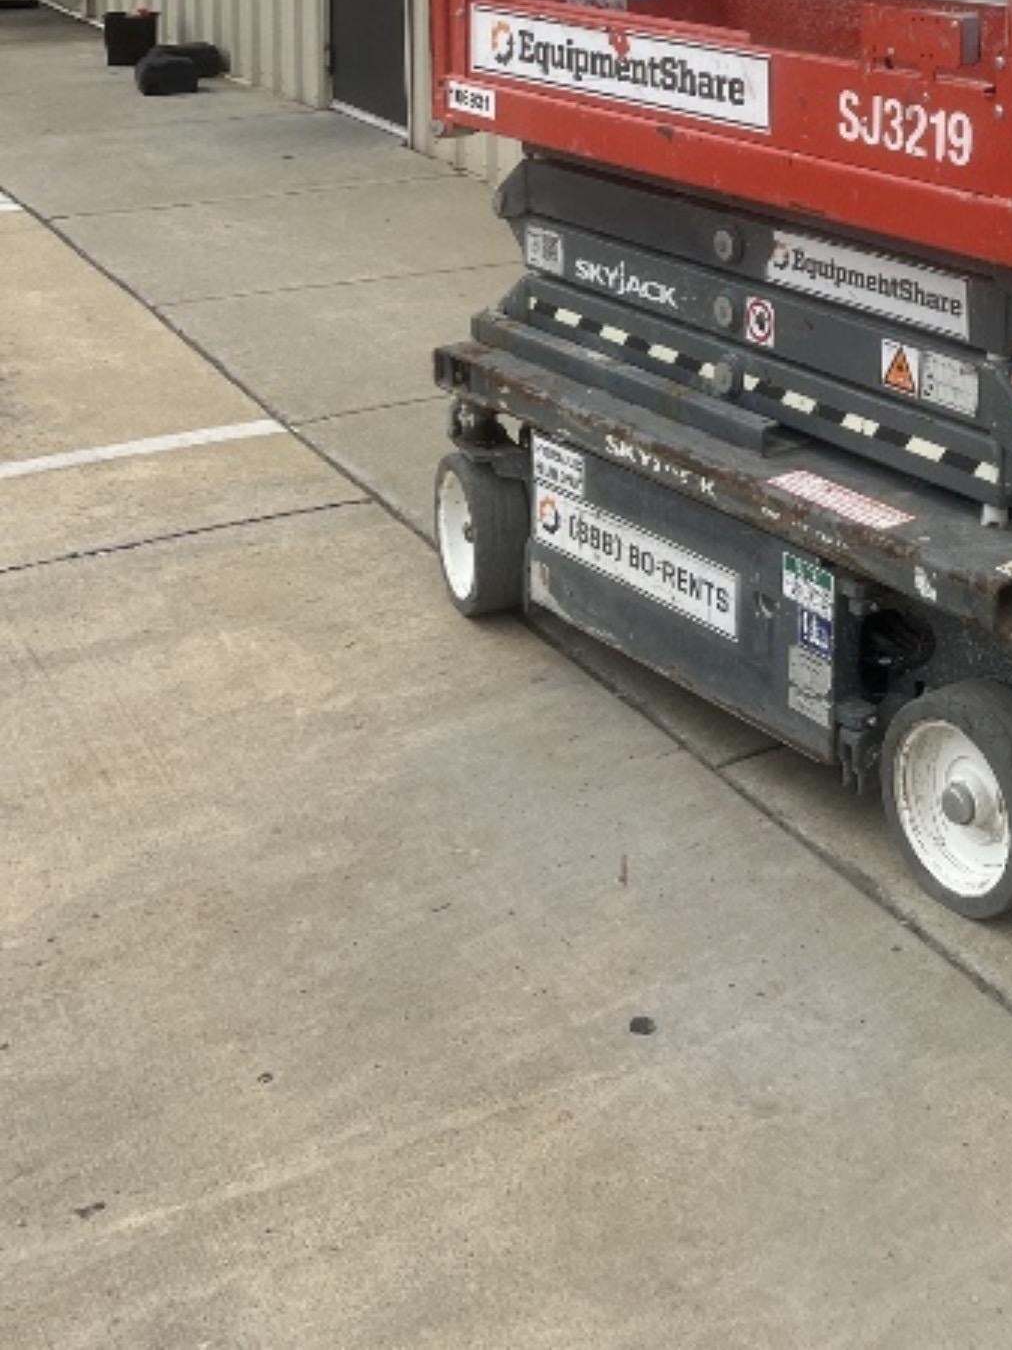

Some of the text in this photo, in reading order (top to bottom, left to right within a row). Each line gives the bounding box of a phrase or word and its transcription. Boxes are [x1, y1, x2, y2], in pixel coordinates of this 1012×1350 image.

[517, 28, 745, 106] EquipmentShare
[838, 88, 974, 167] SJ3219
[574, 258, 680, 310] SKYJACK
[791, 247, 962, 319] EquipmentShare
[568, 512, 623, 562] (888)
